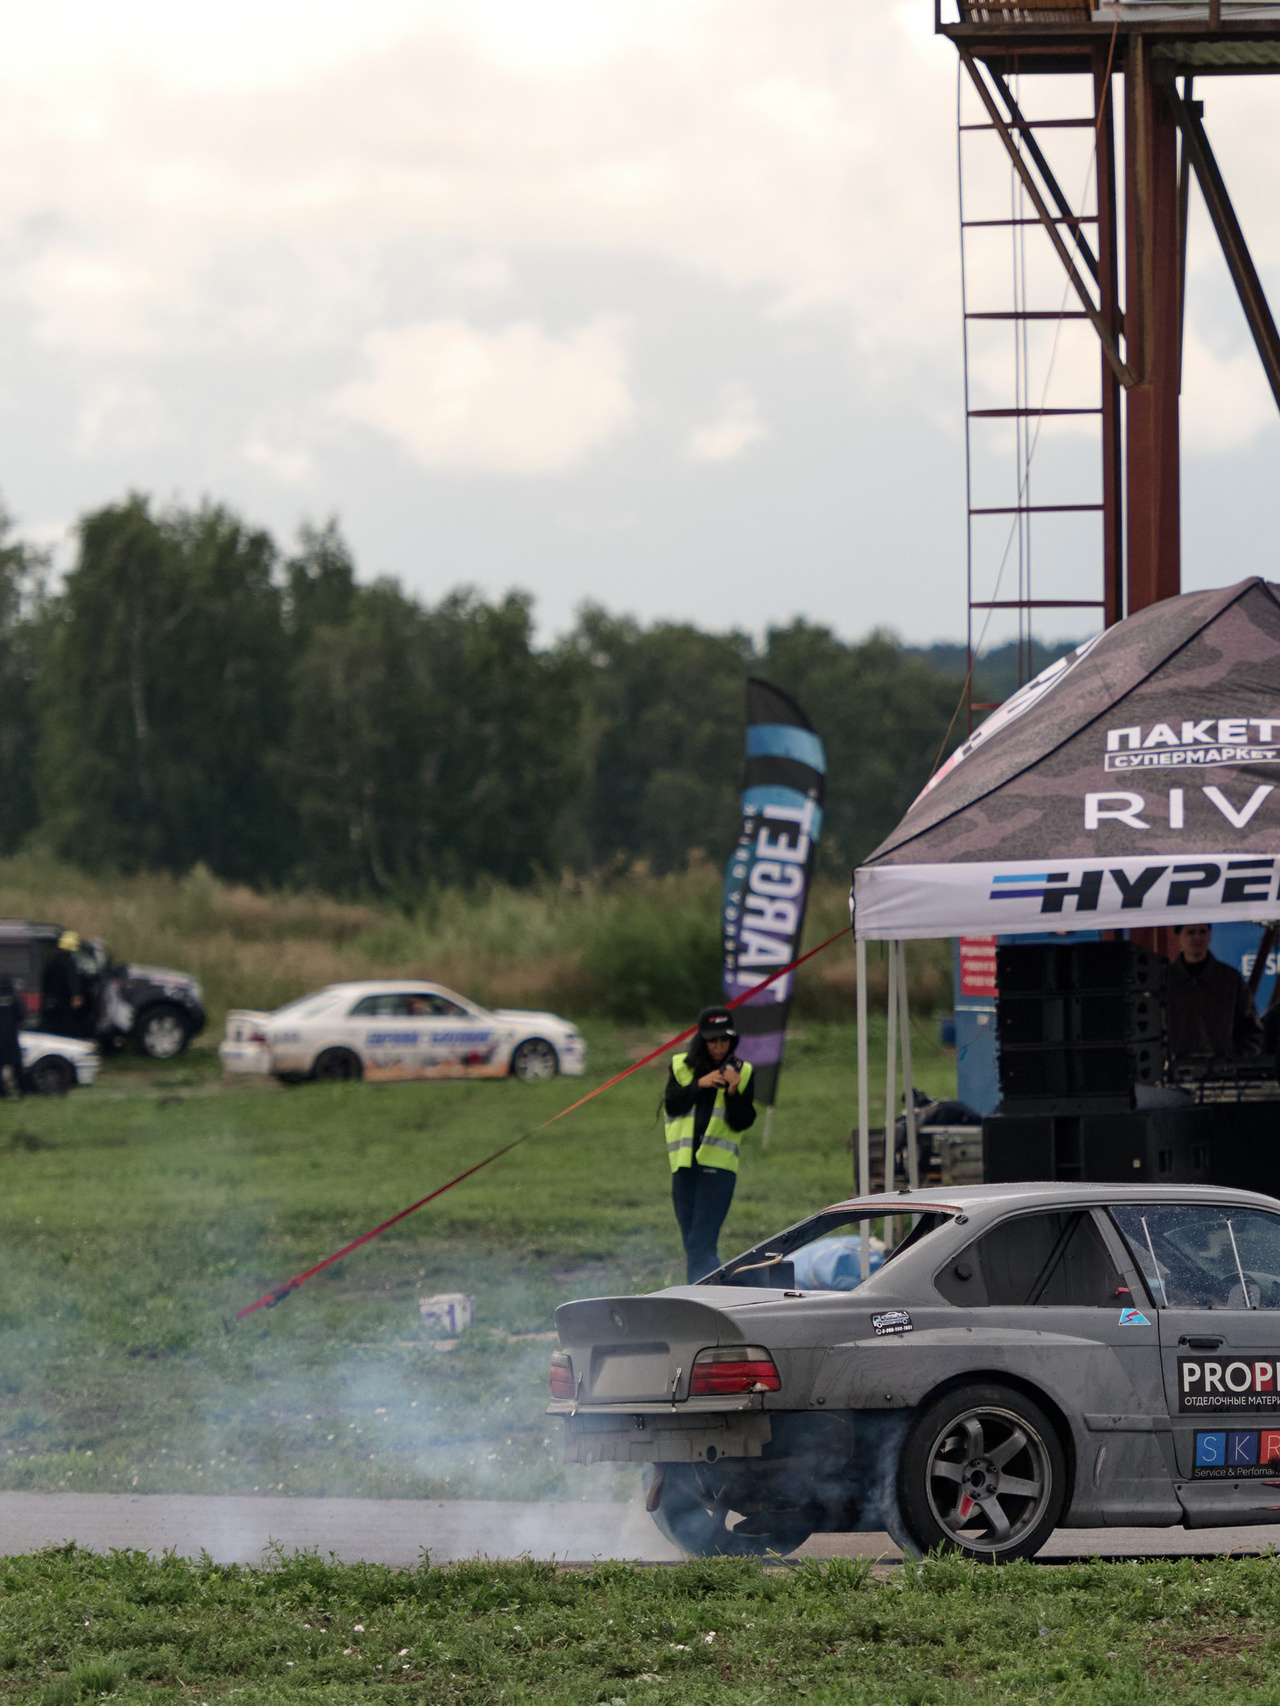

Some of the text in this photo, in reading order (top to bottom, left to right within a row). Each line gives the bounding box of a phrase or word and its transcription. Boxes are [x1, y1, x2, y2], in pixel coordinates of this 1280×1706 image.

[1114, 748, 1276, 767] СУПЕРМАРКЕТ
[1184, 1397, 1247, 1406] ОТДЕЛОЧНЫЕ
[1195, 1469, 1226, 1477] Service
[1227, 1468, 1235, 1476] &
